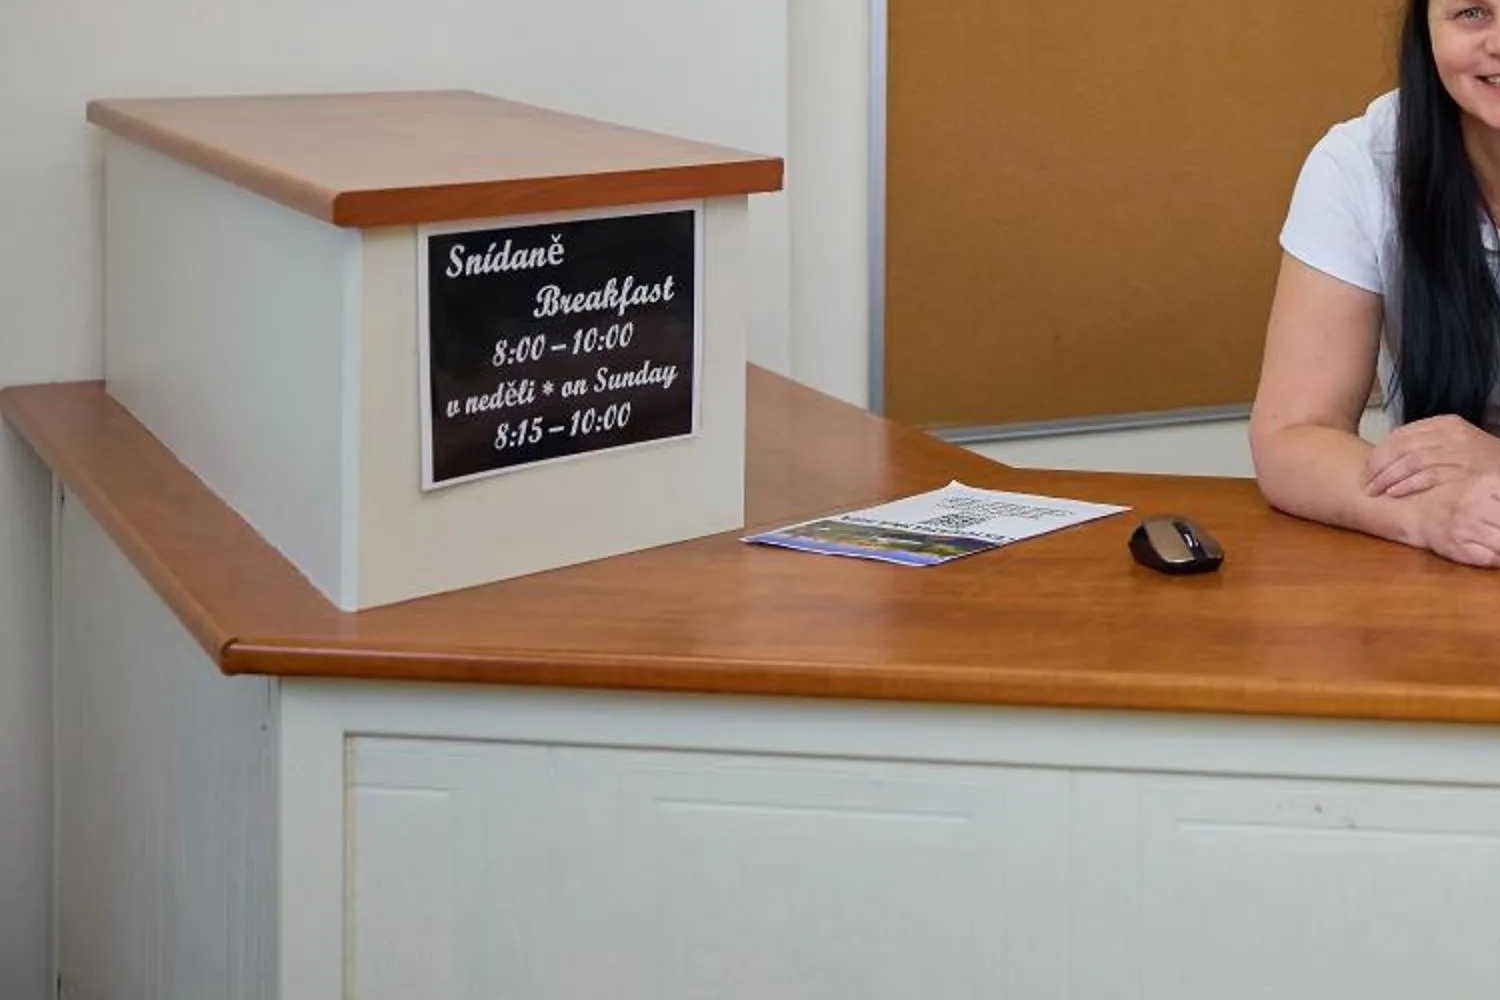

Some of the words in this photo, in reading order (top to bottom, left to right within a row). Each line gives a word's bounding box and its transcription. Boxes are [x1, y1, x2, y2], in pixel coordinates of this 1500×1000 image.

[446, 233, 565, 278] Snídaně
[533, 275, 675, 318] Breakfast
[492, 334, 546, 367] 8:00
[572, 321, 634, 356] 10:00
[446, 400, 461, 418] v
[465, 379, 536, 415] neděli
[561, 380, 589, 399] on
[593, 360, 678, 394] Sunday
[493, 416, 544, 450] 8:15
[569, 401, 631, 437] 10:00
